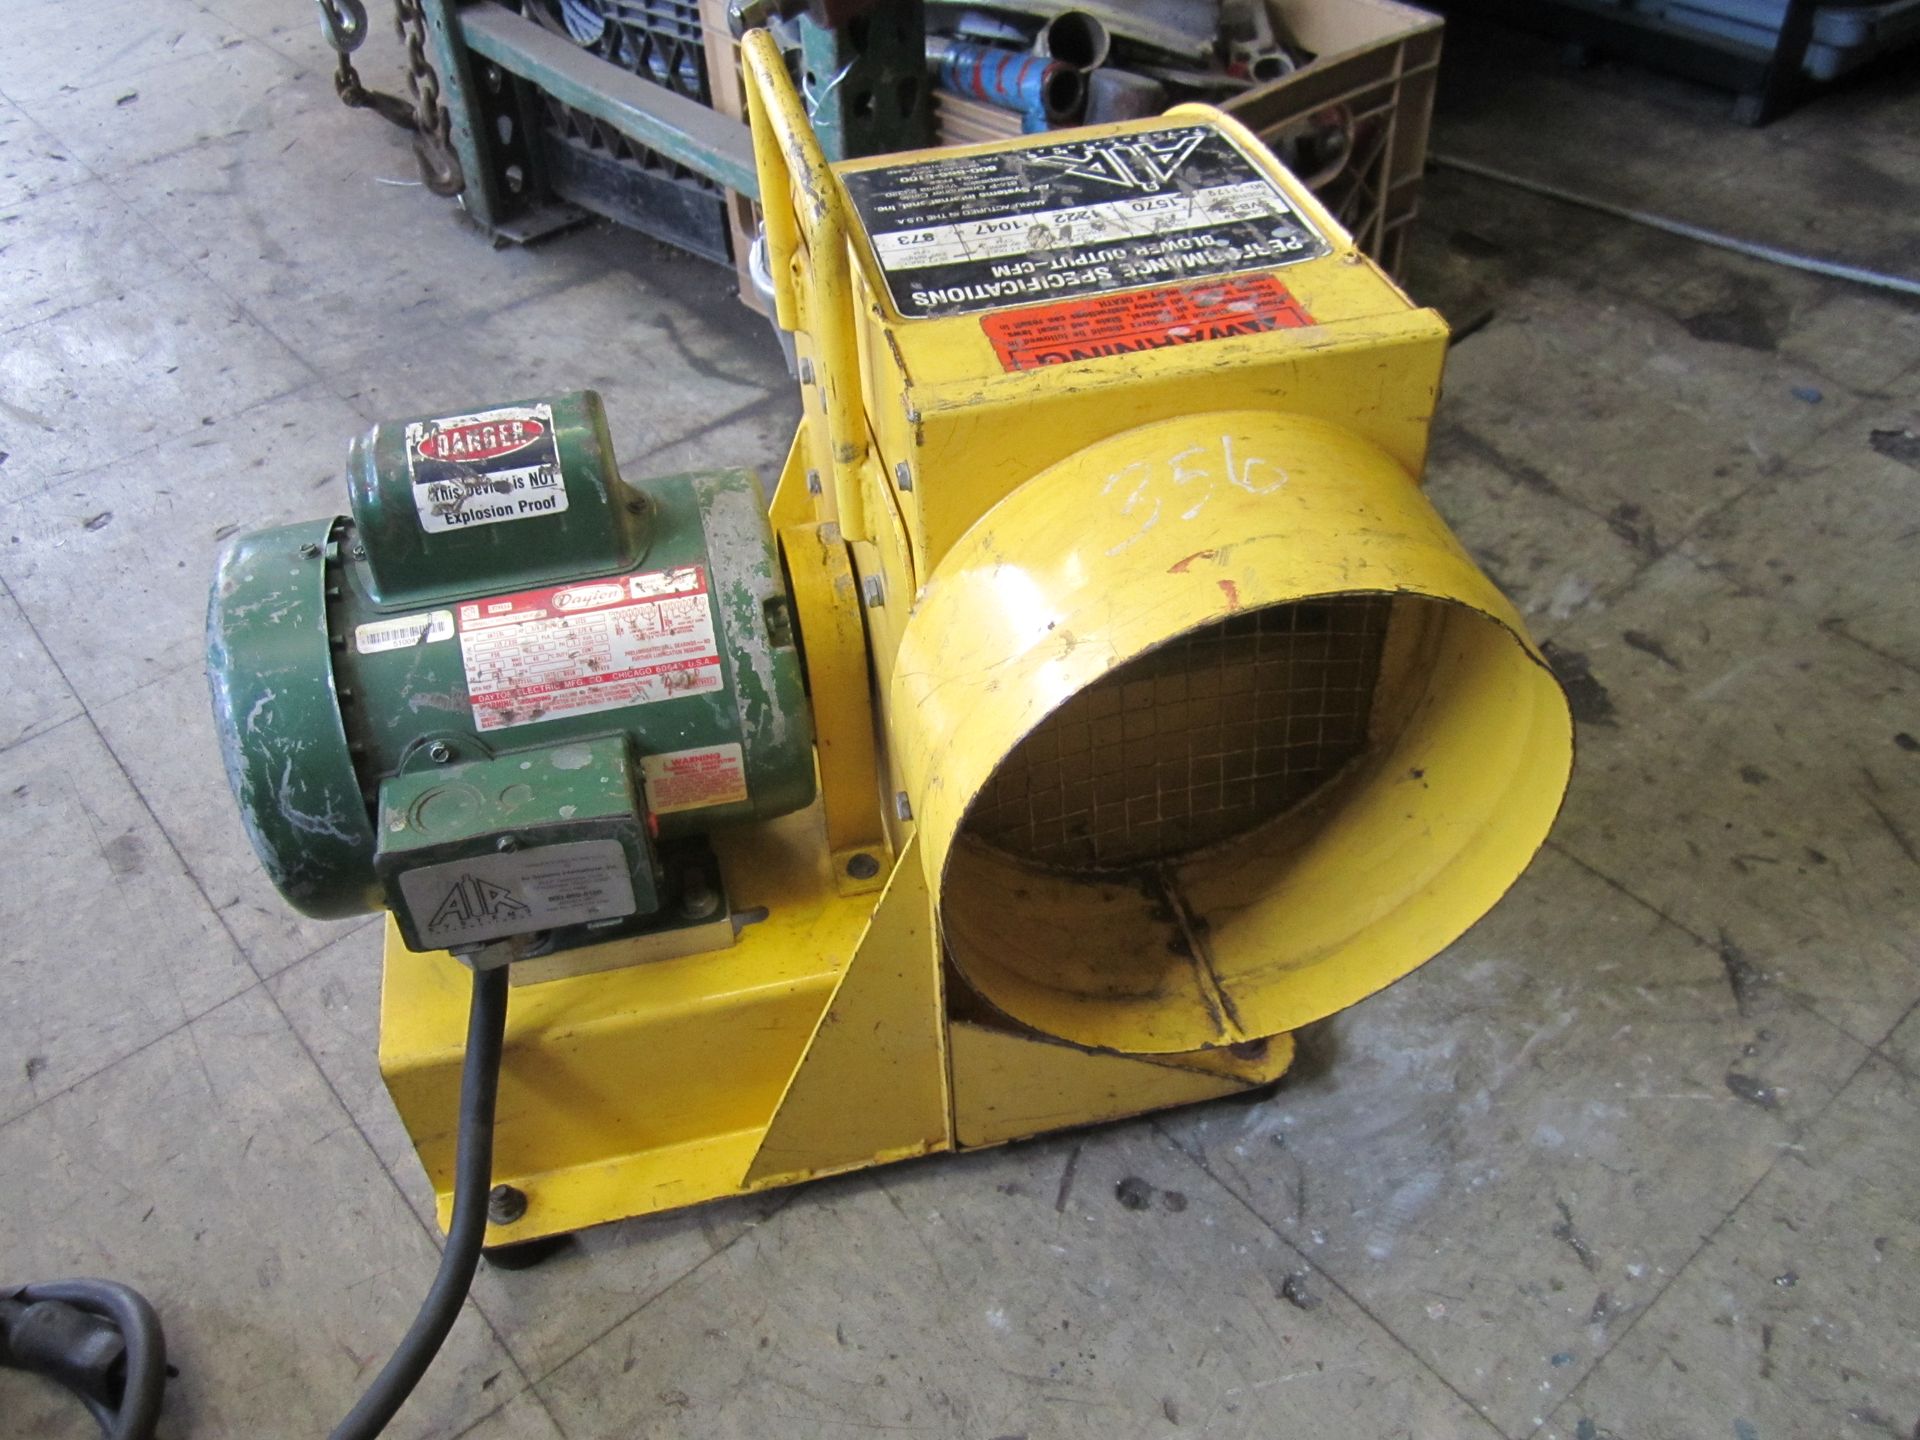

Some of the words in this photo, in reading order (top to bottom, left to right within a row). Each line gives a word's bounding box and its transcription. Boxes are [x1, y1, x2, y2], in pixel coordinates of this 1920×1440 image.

[1049, 208, 1100, 223] 1222
[1128, 197, 1180, 212] 1570
[895, 231, 937, 245] 873
[970, 219, 1023, 235] 1047
[1115, 235, 1307, 278] PERFORMANCE
[1130, 233, 1217, 257] BLOWER
[908, 265, 1115, 307] SPECIFICATIONS
[436, 421, 527, 459] DANGER
[513, 475, 525, 490] is
[529, 470, 557, 489] NOT
[1101, 435, 1290, 557] 356
[445, 503, 514, 526] Explosion
[519, 494, 557, 515] Proof
[556, 588, 618, 608] Dayton
[516, 681, 560, 696] ELECTRIC
[612, 666, 653, 680] CHICAGO
[686, 656, 712, 667] U.S.A.
[671, 752, 721, 767] WARNING
[427, 873, 530, 928] AIR
